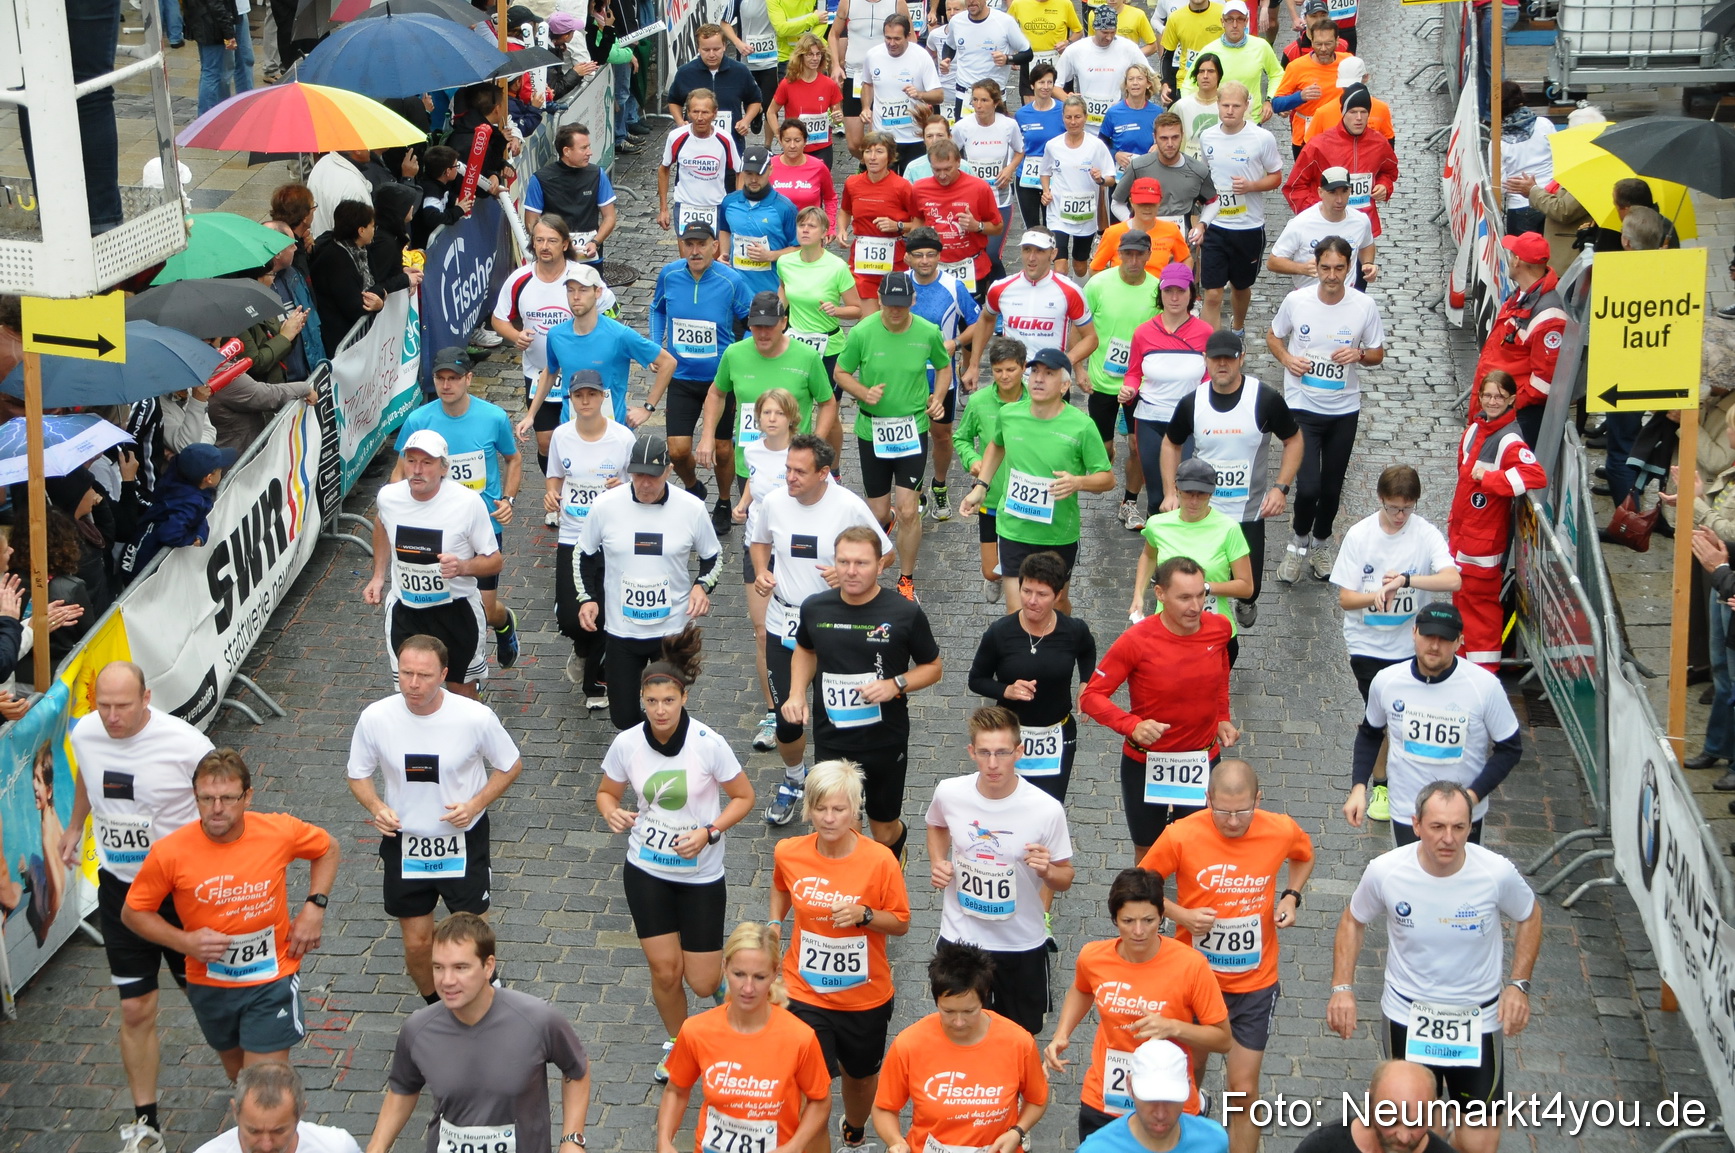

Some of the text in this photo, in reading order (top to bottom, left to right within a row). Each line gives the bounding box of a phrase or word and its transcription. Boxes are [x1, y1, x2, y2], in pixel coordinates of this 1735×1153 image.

[882, 104, 908, 118] 2472
[1088, 102, 1108, 114] 392
[466, 163, 478, 186] BKK
[794, 180, 812, 190] Pain
[1064, 200, 1092, 214] 5021
[683, 211, 713, 224] 2959
[864, 246, 886, 260] 158
[526, 311, 562, 319] GERHART
[1594, 292, 1700, 324] Jugend-
[1008, 316, 1054, 330] Hako
[677, 328, 713, 344] 2368
[1622, 324, 1671, 350] lauf
[685, 346, 705, 354] Roland
[1111, 347, 1128, 364] 29
[1308, 360, 1344, 380] 3063
[877, 424, 913, 442] 3020
[452, 464, 472, 480] 35
[1214, 471, 1245, 487] 692
[570, 489, 597, 504] 239
[1011, 482, 1048, 505] 2821
[1013, 502, 1041, 516] Christian
[401, 572, 444, 592] 3036
[626, 588, 667, 608] 2994
[632, 610, 659, 618] Michael
[828, 688, 868, 706] 312
[1405, 710, 1425, 719] PARTL
[1408, 720, 1460, 744] 3165
[1024, 738, 1057, 756] 053
[1148, 756, 1199, 764] PARTL Neumarkt
[1152, 764, 1203, 784] 3102
[644, 815, 661, 825] PARTL
[100, 826, 150, 849] 2546
[645, 827, 680, 850] 274
[408, 836, 460, 858] 2884
[424, 862, 444, 870] Fred
[652, 854, 682, 866] Kerstin
[956, 860, 1004, 878] PARTL Neumarkt
[962, 871, 1010, 900] 2016
[1210, 874, 1271, 888] Fischer
[208, 880, 271, 900] Fischer
[214, 890, 268, 906] AUTOMOBILE
[802, 886, 861, 904] Fischer
[807, 900, 832, 908] AUTOM
[964, 897, 1004, 913] Sebastian
[1216, 922, 1250, 930] Neumarkt
[802, 936, 854, 950] PARTL Neumarkt
[1200, 930, 1256, 952] 2789
[219, 940, 269, 965] 784
[805, 948, 861, 973] 2785
[1206, 953, 1246, 965] Christian
[822, 976, 842, 986] Gabi
[1104, 992, 1167, 1011] Fischer
[1412, 1003, 1436, 1016] PARTL
[1415, 1016, 1472, 1042] 2851
[1424, 1044, 1462, 1058] Günther
[1107, 1055, 1130, 1066] PARTL
[714, 1073, 779, 1090] Fischer
[718, 1088, 773, 1098] AUTOMOBILE
[937, 1083, 1004, 1098] Fischer
[730, 1102, 744, 1110] und
[954, 1113, 970, 1121] und
[971, 1110, 984, 1119] das
[441, 1127, 501, 1141] PARTL Neumarkt
[710, 1126, 766, 1153] 2781
